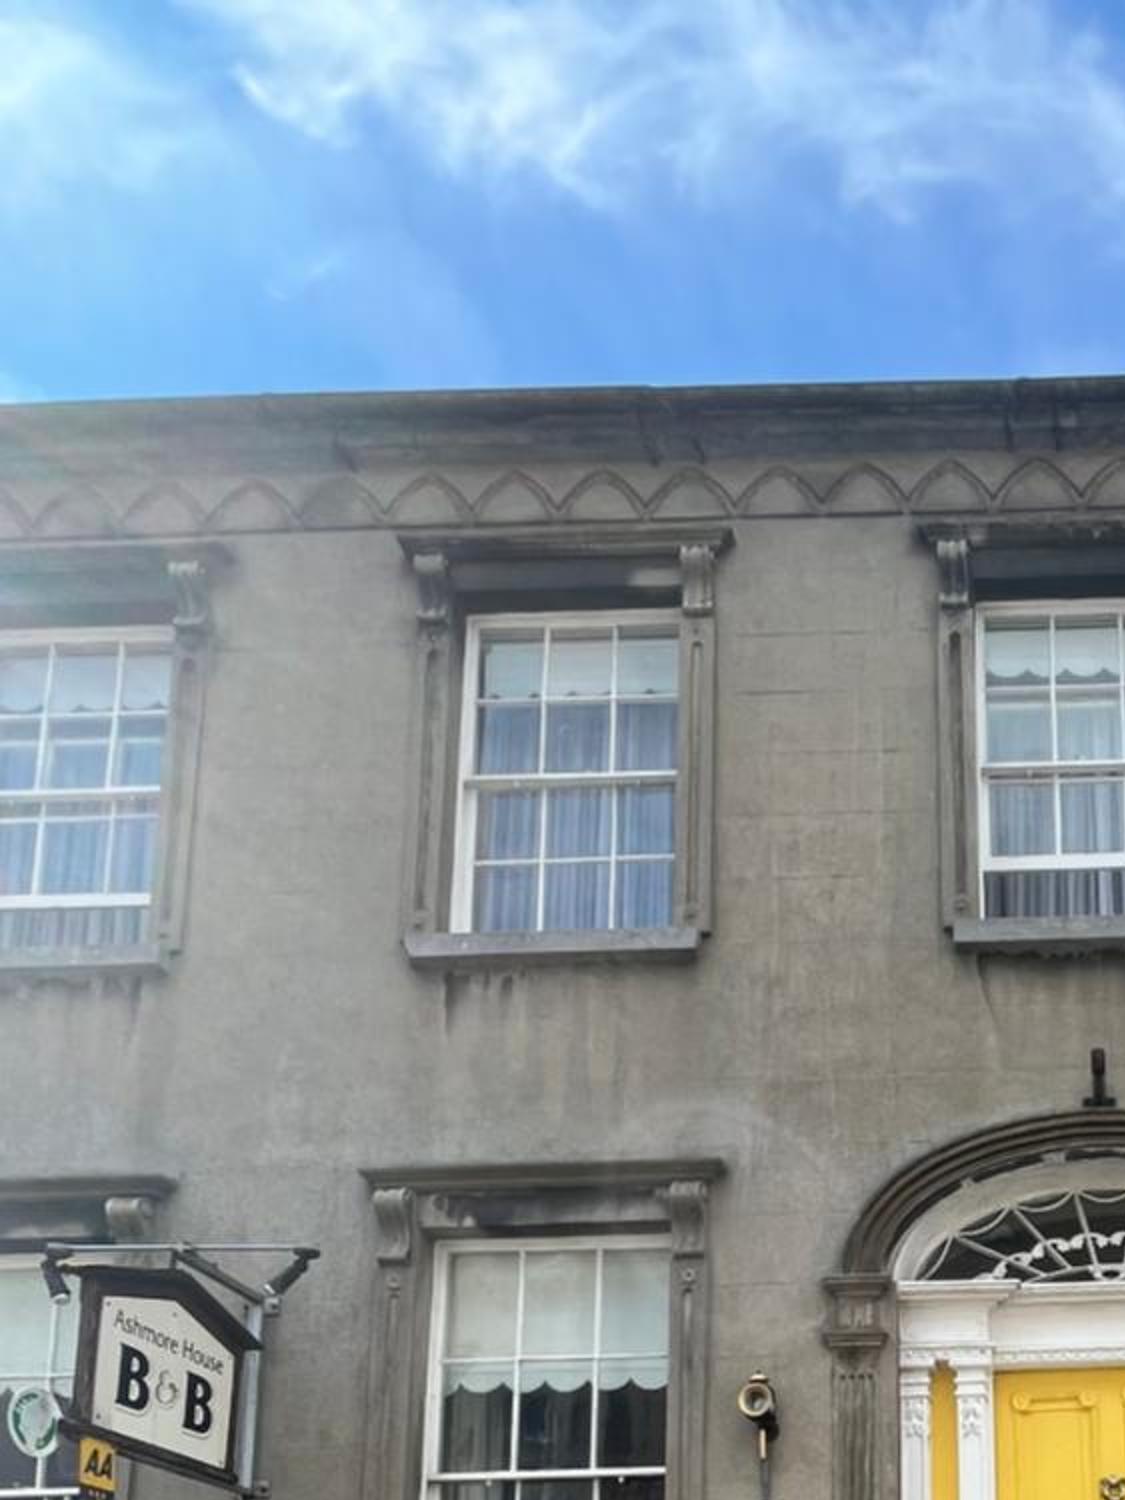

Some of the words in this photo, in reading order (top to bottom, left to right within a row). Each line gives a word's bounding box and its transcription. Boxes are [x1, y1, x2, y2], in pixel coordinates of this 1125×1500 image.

[114, 1309, 179, 1354] Ashmore
[182, 1340, 224, 1376] House
[84, 1448, 112, 1480] AA
